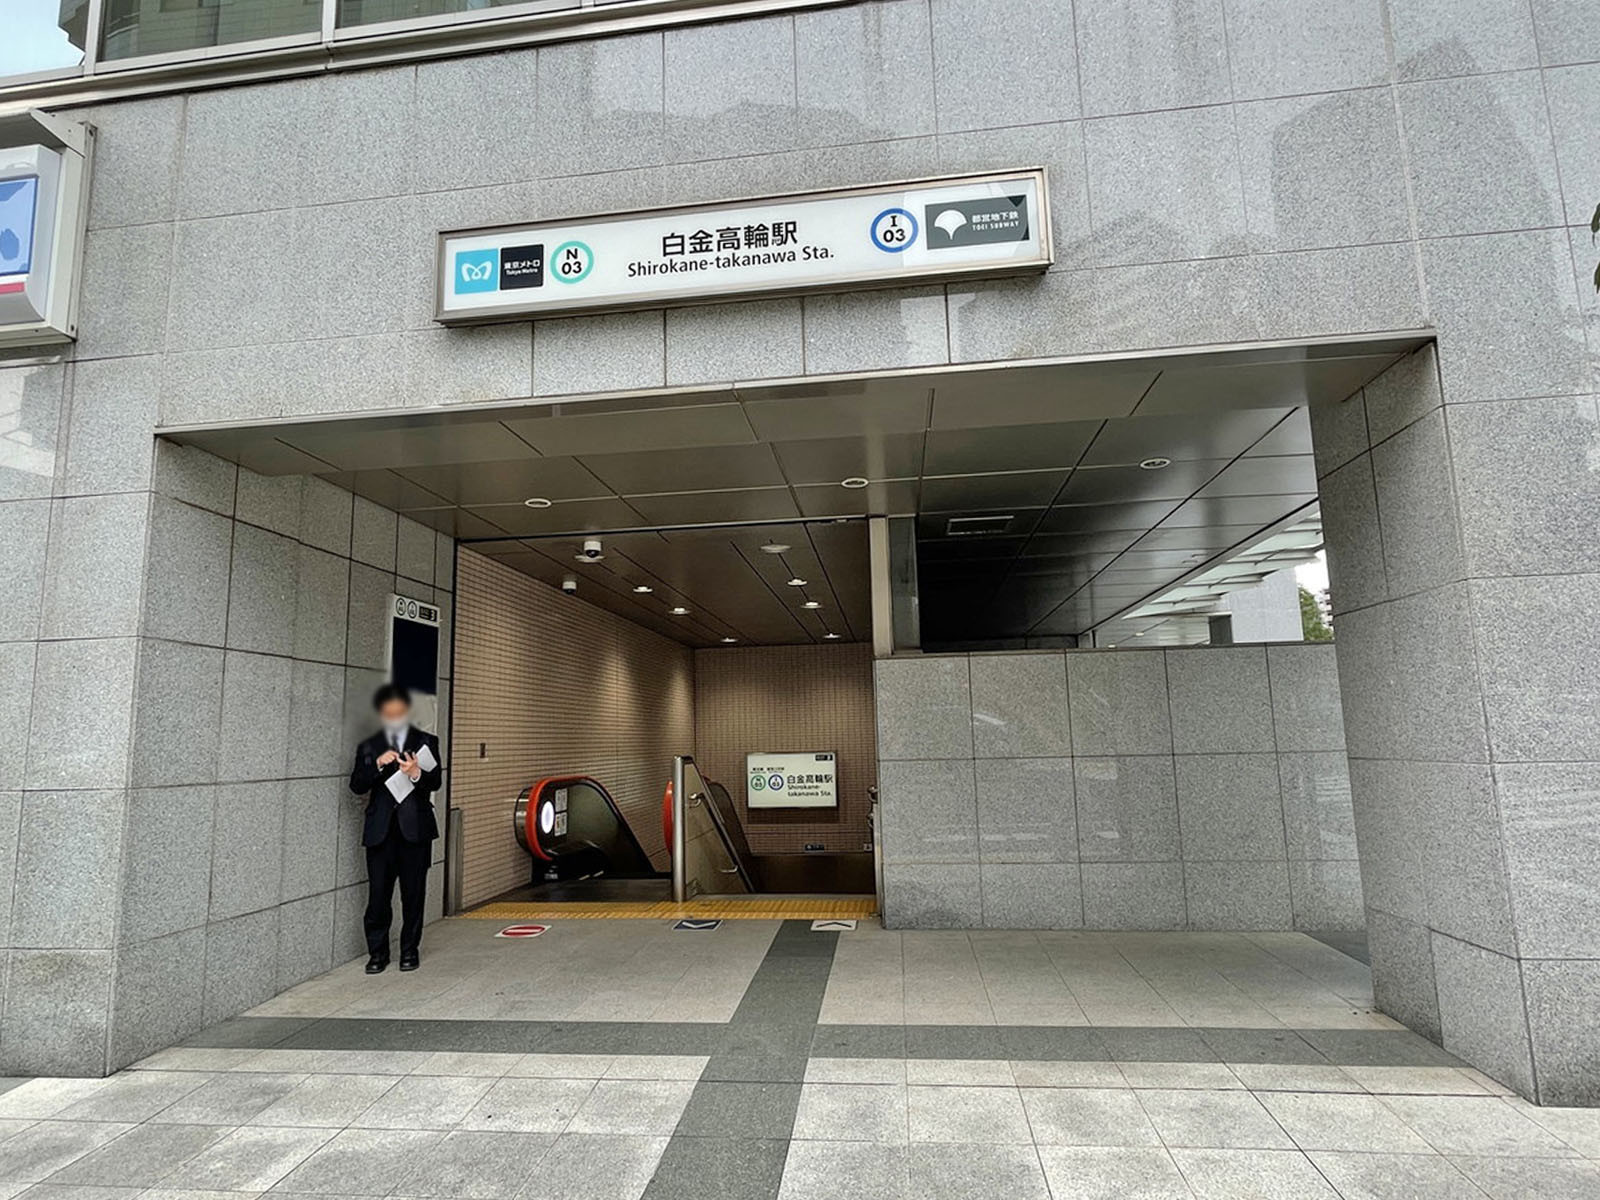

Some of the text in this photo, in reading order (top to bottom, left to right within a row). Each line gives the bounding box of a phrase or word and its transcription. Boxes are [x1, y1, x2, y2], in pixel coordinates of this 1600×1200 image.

[972, 211, 1019, 223] 都営地下鉄
[662, 220, 798, 257] 白金高輪駅
[883, 228, 906, 243] 03
[566, 247, 578, 260] N
[504, 259, 541, 269] 東京メトロ
[561, 261, 582, 275] 03
[628, 245, 835, 278] Shirokane-takanawa Sta.
[787, 774, 833, 784] 白金高輪駅
